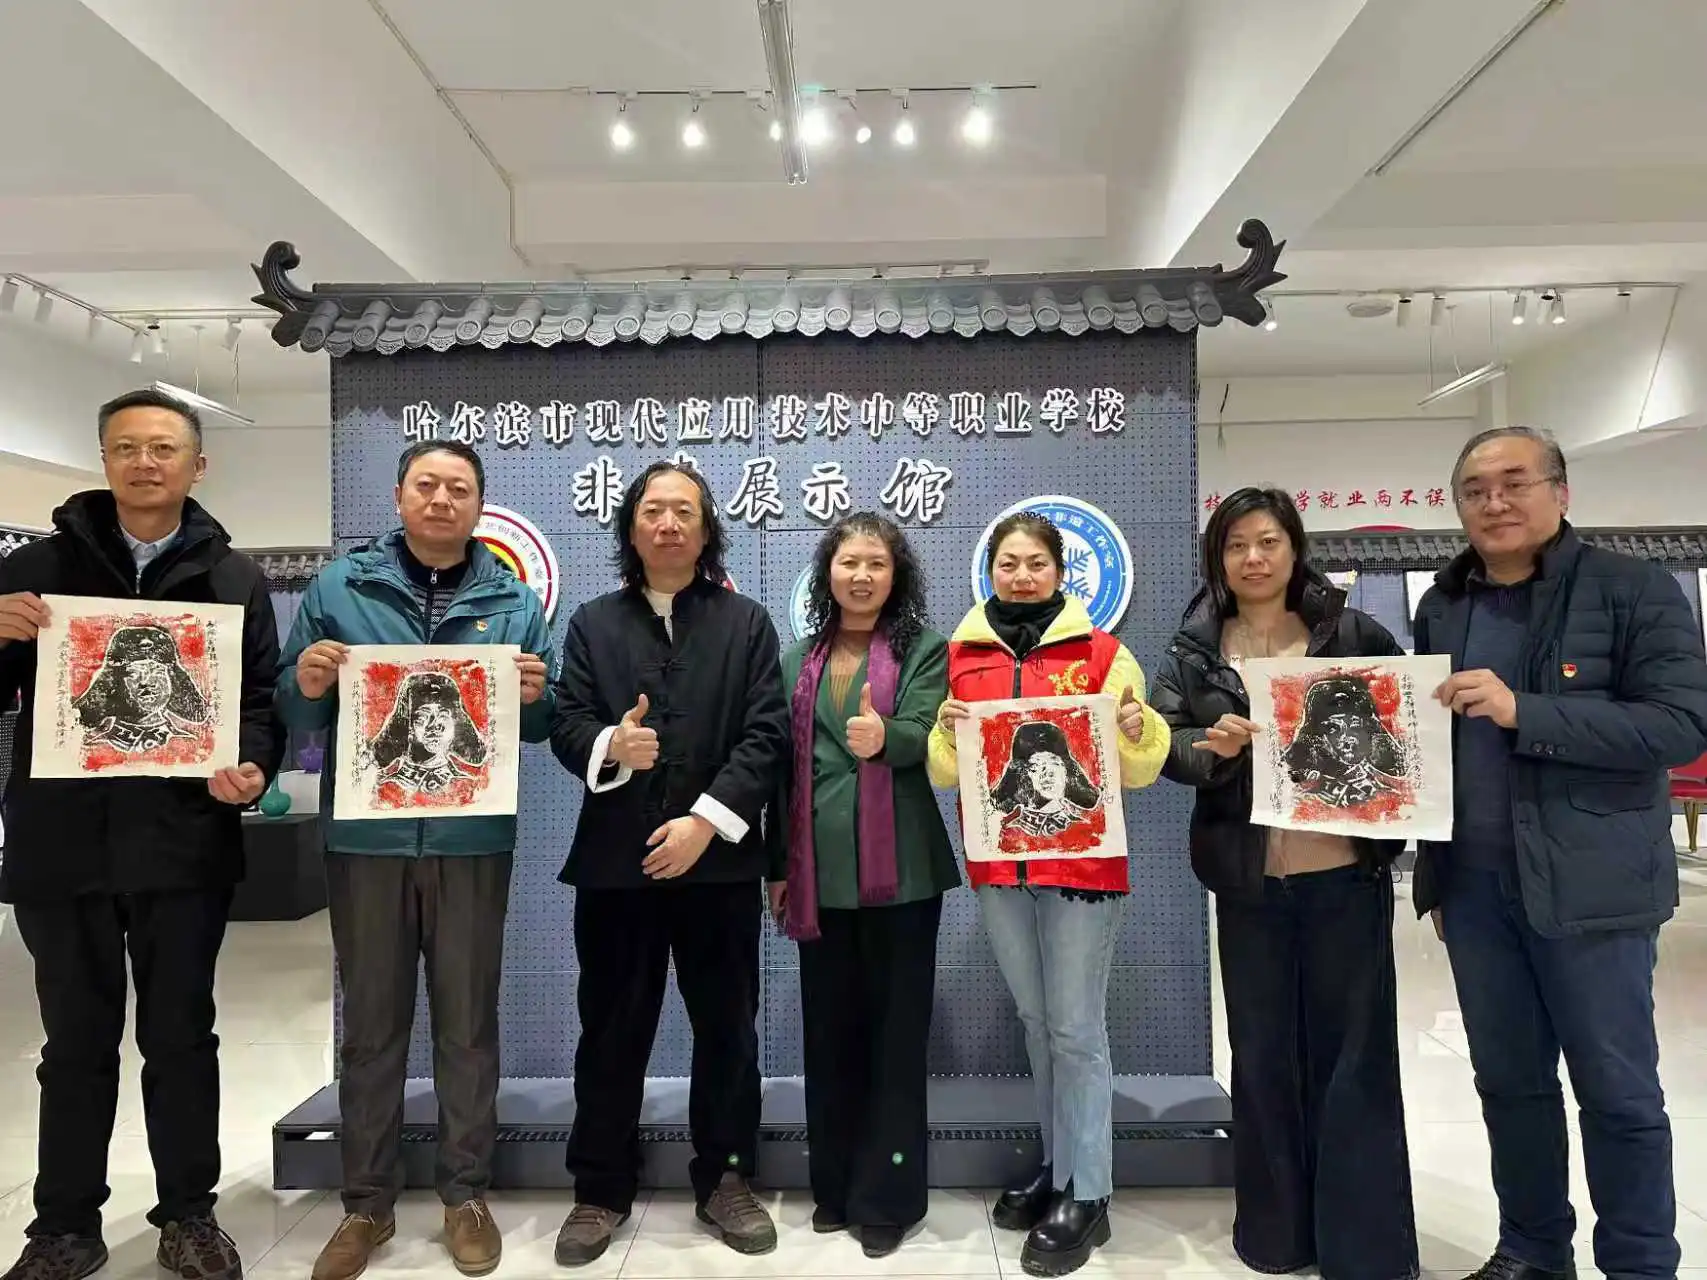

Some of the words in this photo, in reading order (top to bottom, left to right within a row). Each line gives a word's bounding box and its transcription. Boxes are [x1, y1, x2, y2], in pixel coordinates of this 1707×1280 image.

[402, 388, 1126, 445] 哈尔滨市现代应用技术中等职业学校
[573, 450, 953, 524] 非展示馆
